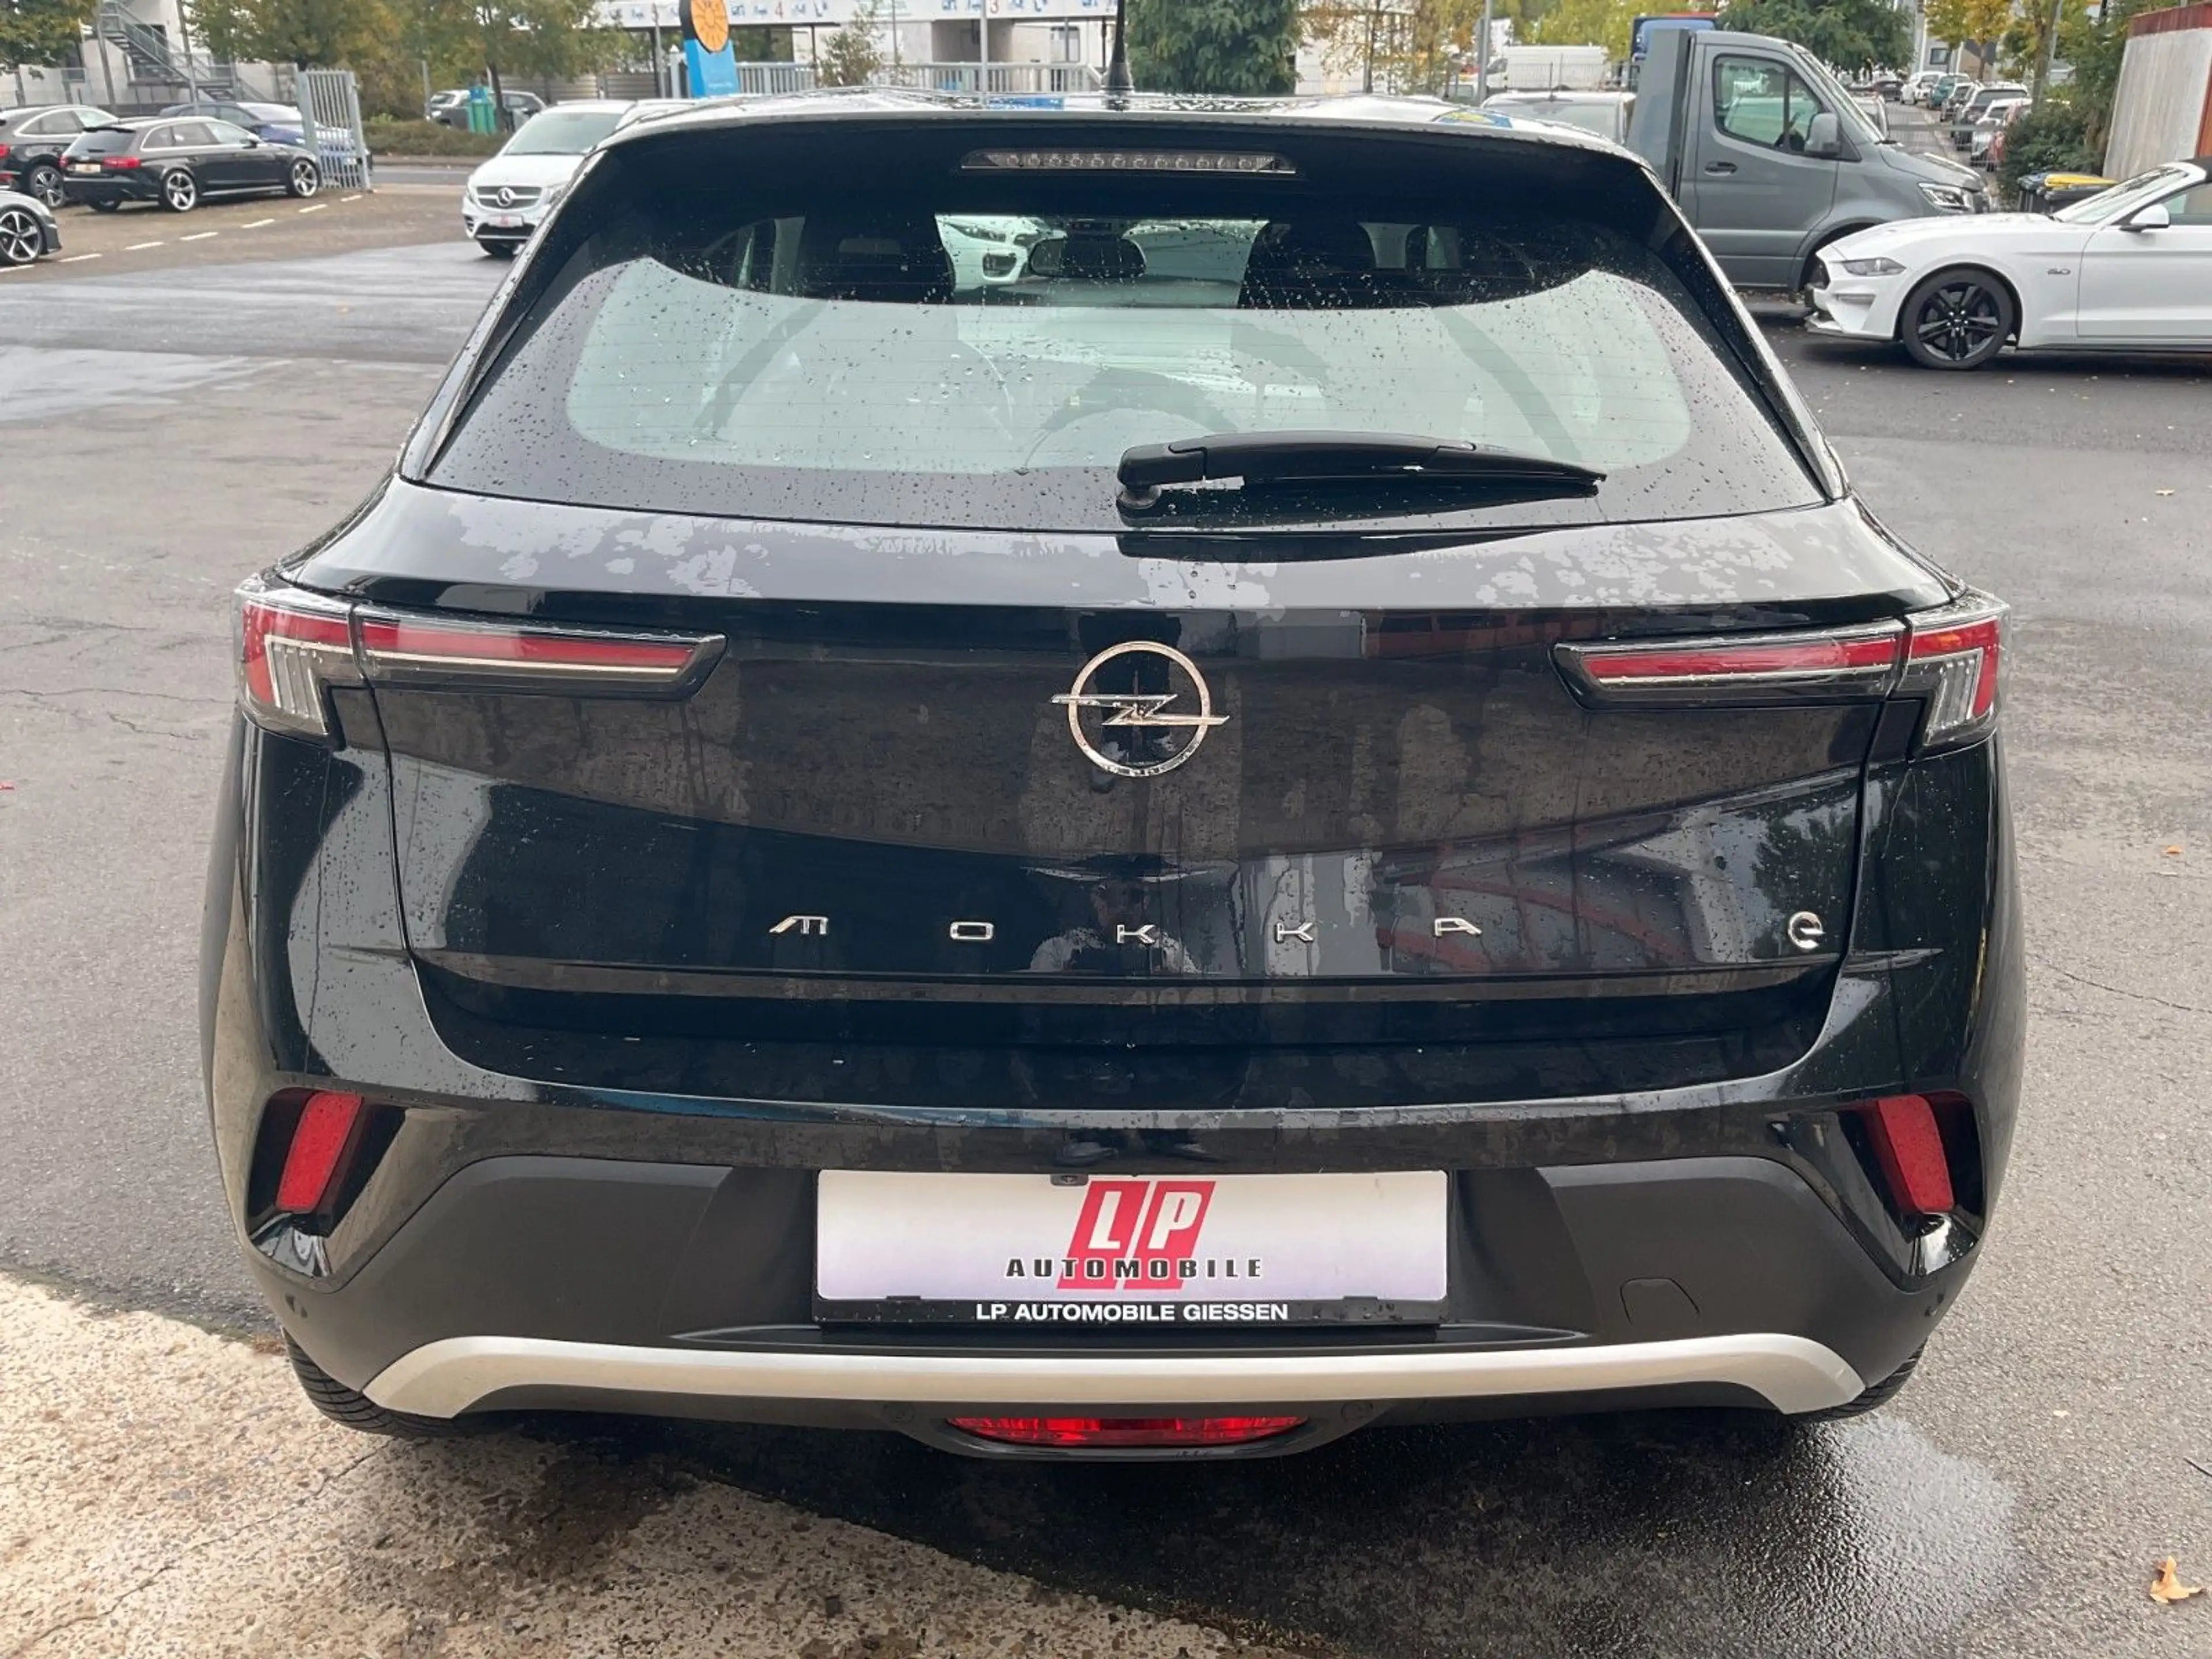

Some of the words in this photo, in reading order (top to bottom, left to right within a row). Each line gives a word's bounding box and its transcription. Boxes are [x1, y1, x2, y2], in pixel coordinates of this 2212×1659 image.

[1088, 1191, 1202, 1249] LP
[1006, 1258, 1262, 1278] AUTOMOBILE
[976, 1304, 1007, 1320] LP
[1014, 1304, 1176, 1321] AUTOMOBILE
[1183, 1305, 1288, 1321] GIESSEN
